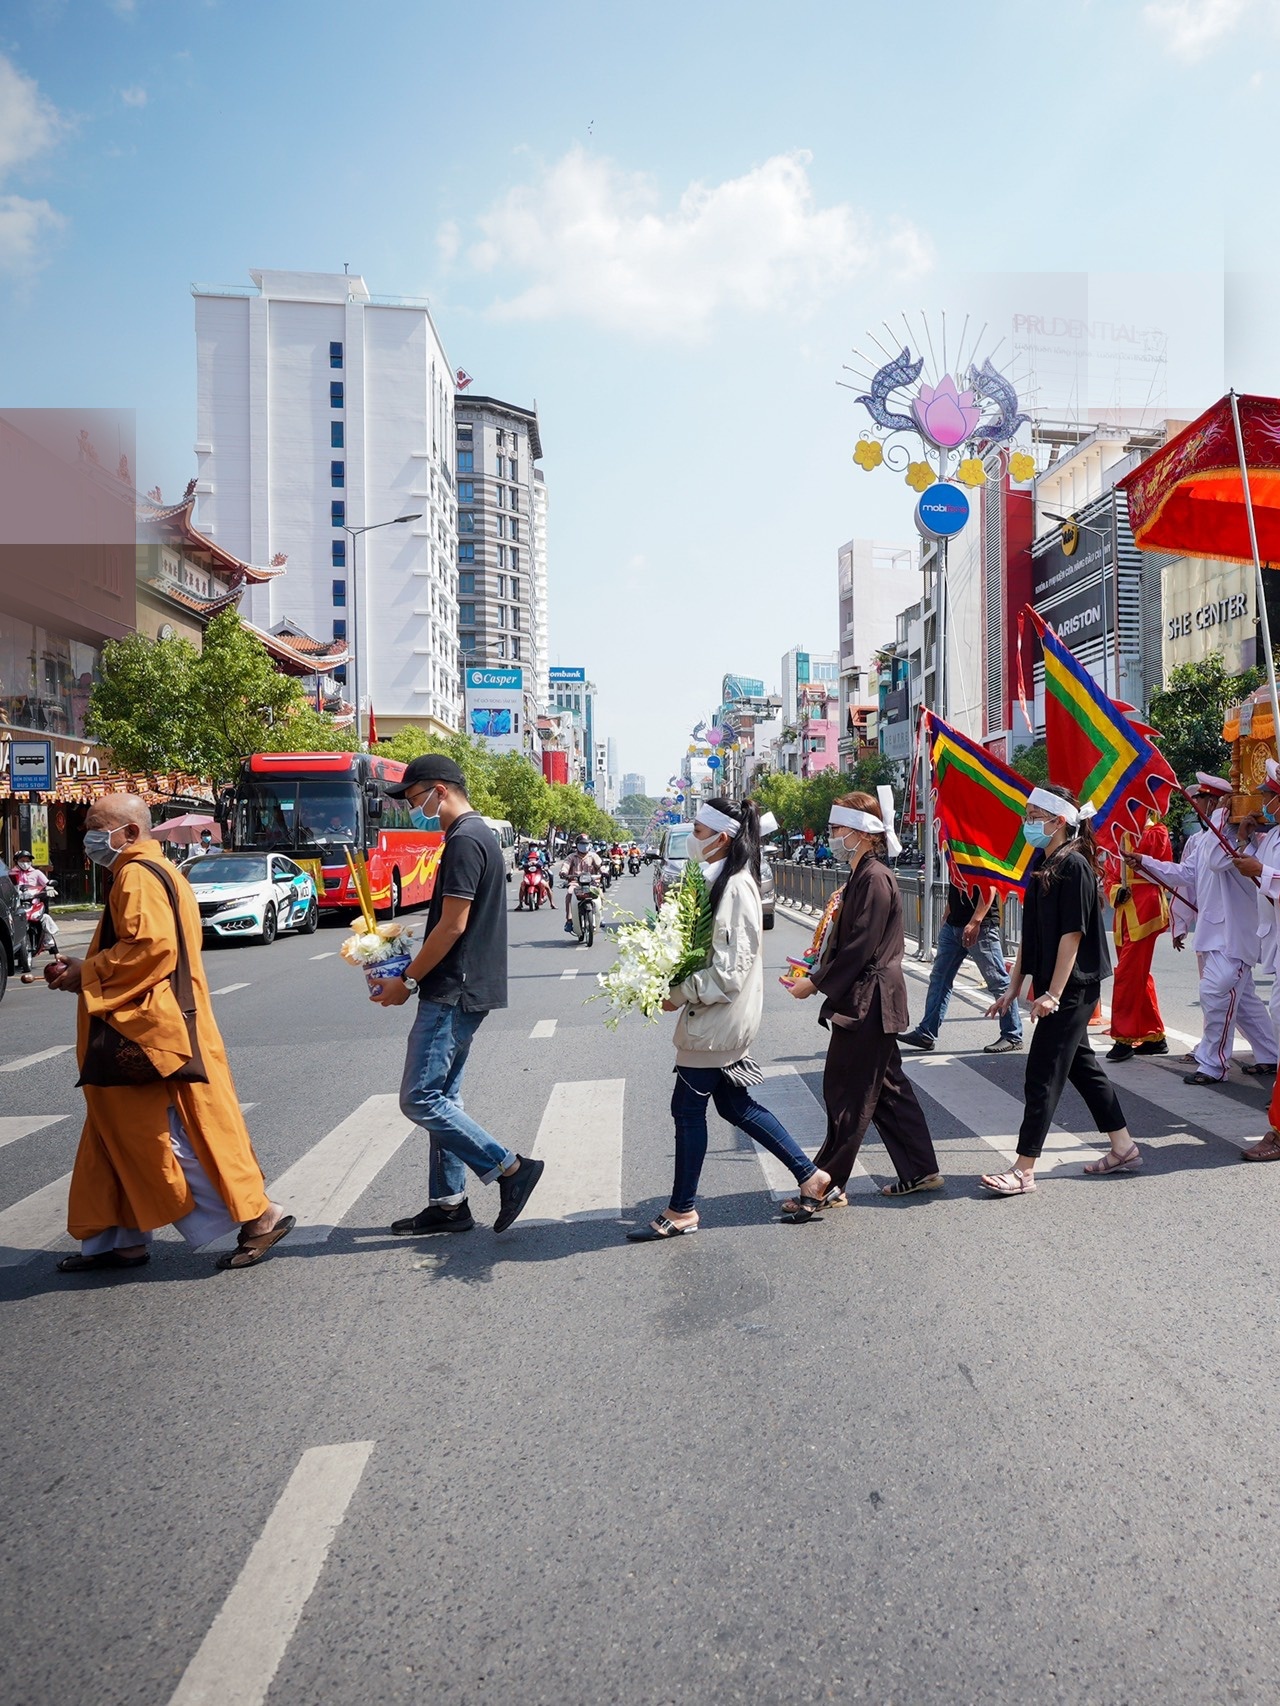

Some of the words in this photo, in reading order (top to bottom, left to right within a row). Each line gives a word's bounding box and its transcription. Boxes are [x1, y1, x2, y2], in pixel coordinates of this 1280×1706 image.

[1012, 313, 1141, 345] PRUDENTIAL
[1057, 604, 1101, 638] ARISTON
[1168, 611, 1192, 641] SHE
[1195, 592, 1248, 631] CENTER
[483, 673, 518, 686] Casper
